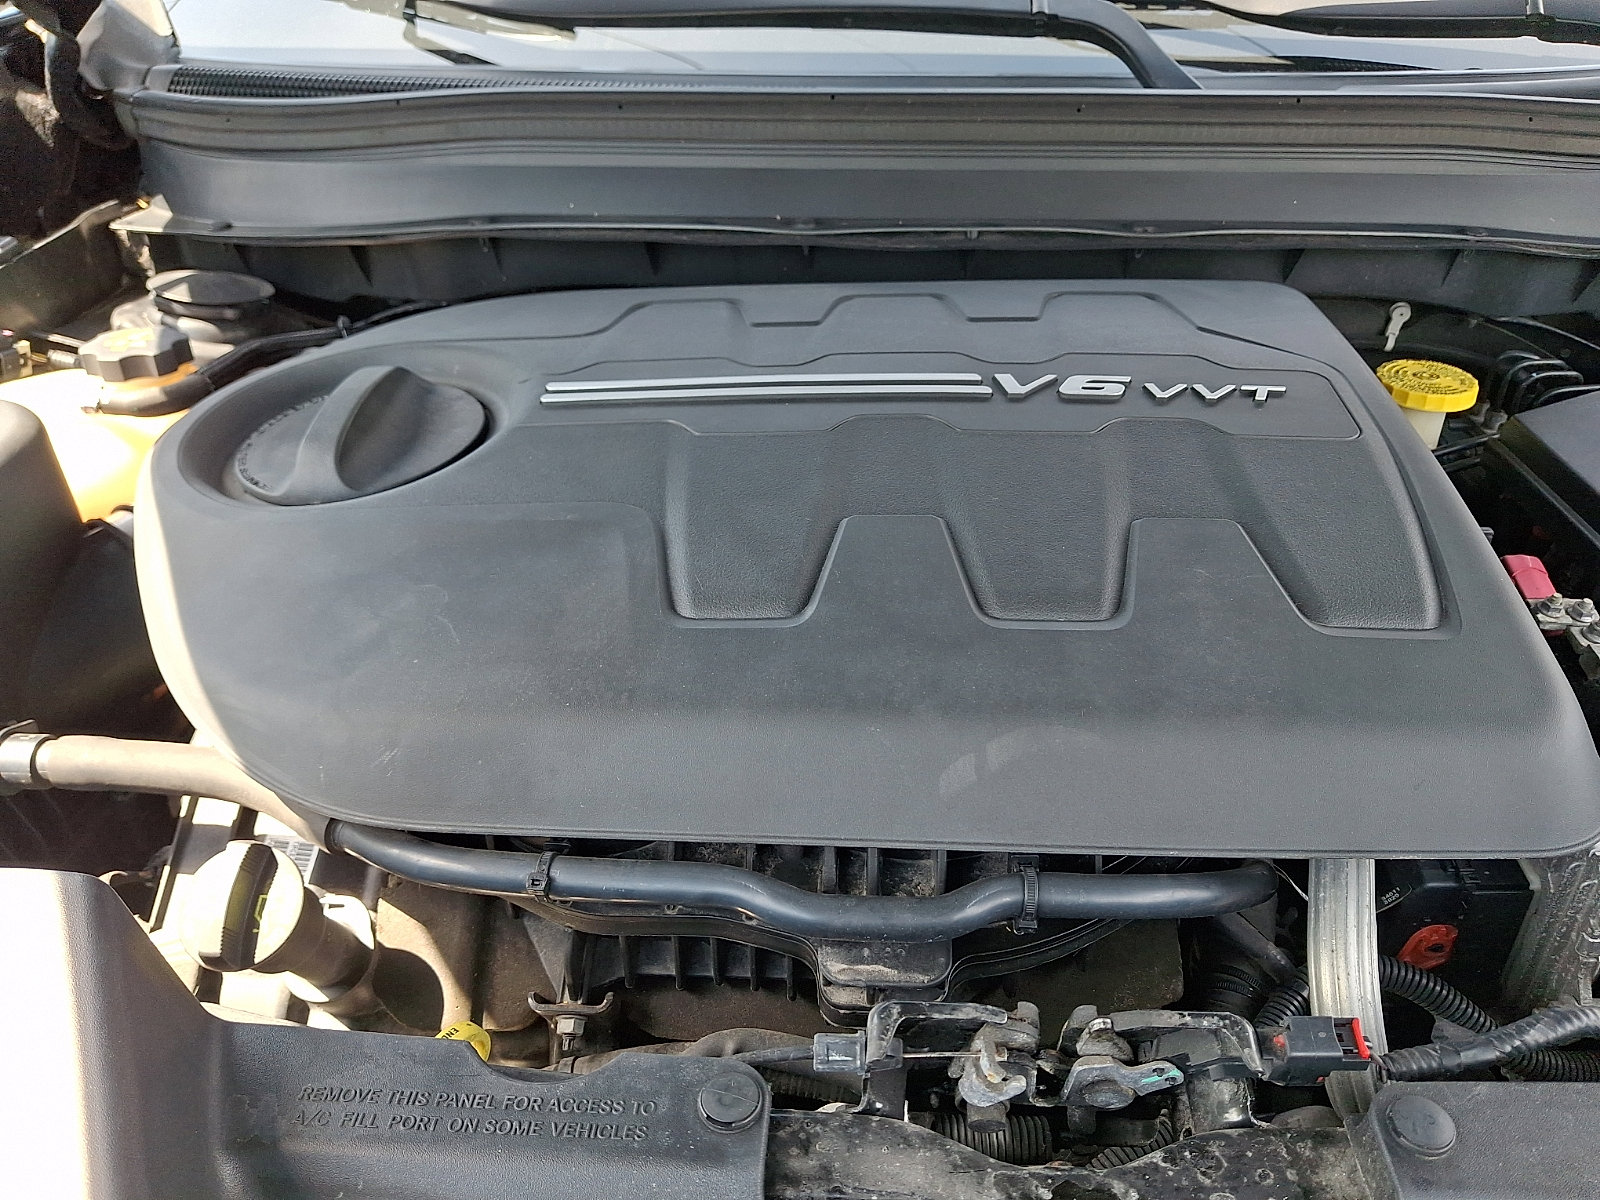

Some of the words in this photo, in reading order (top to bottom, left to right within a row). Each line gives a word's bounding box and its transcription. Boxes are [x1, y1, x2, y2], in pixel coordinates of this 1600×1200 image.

[993, 373, 1132, 400] V6
[1142, 382, 1287, 402] VVT
[298, 1086, 382, 1104] REMOVE
[386, 1090, 431, 1107] THIS
[434, 1092, 497, 1109] PANEL
[502, 1095, 543, 1112] FOR
[546, 1097, 626, 1115] ACCESS
[631, 1099, 658, 1116] TO
[289, 1109, 331, 1127] A/C
[340, 1112, 379, 1129] FILL
[387, 1114, 443, 1132] PORT
[447, 1117, 480, 1133] ON
[482, 1118, 544, 1136] SOME
[551, 1121, 649, 1141] VEHICLES
